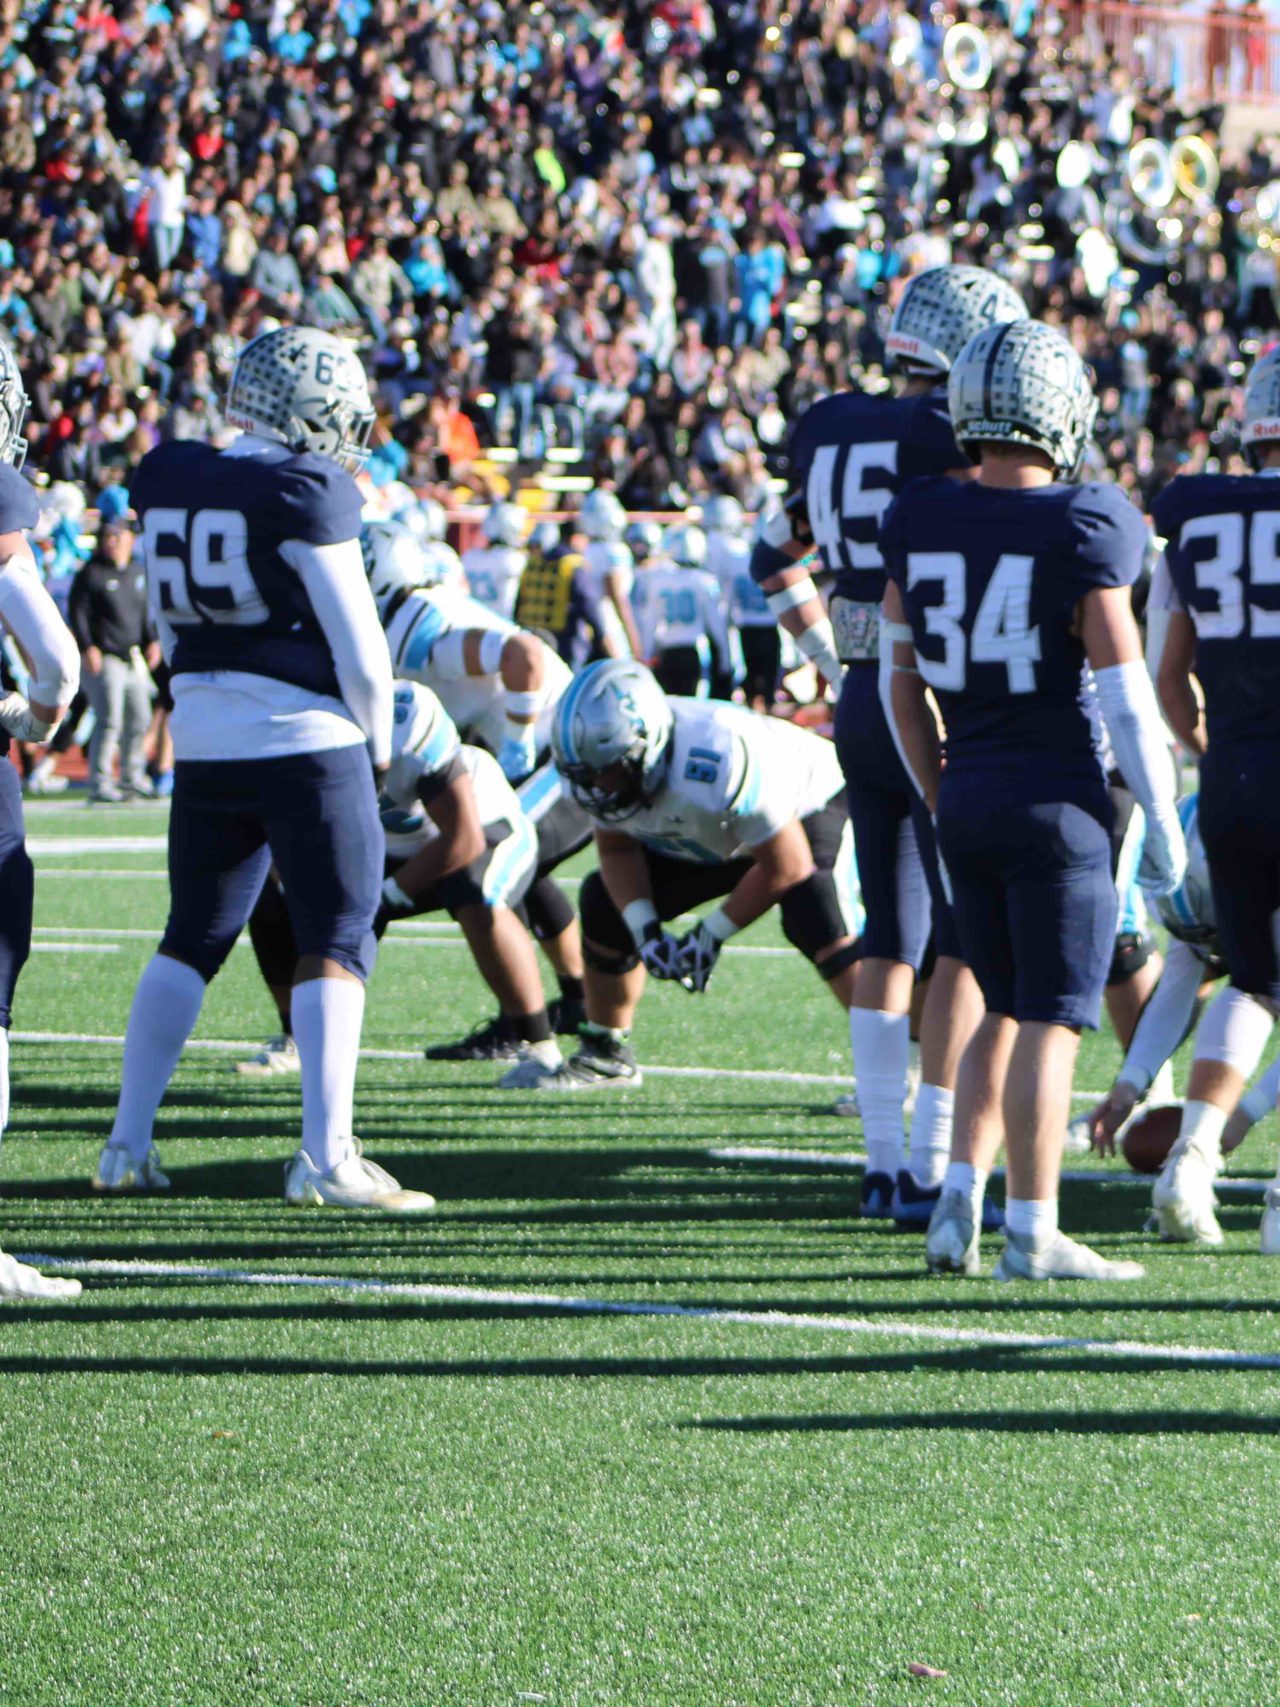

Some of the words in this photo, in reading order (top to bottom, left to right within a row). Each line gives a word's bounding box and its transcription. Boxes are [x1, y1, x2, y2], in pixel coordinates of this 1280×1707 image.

[143, 508, 270, 625] 69
[806, 441, 899, 571] 45
[906, 551, 1042, 694] 34
